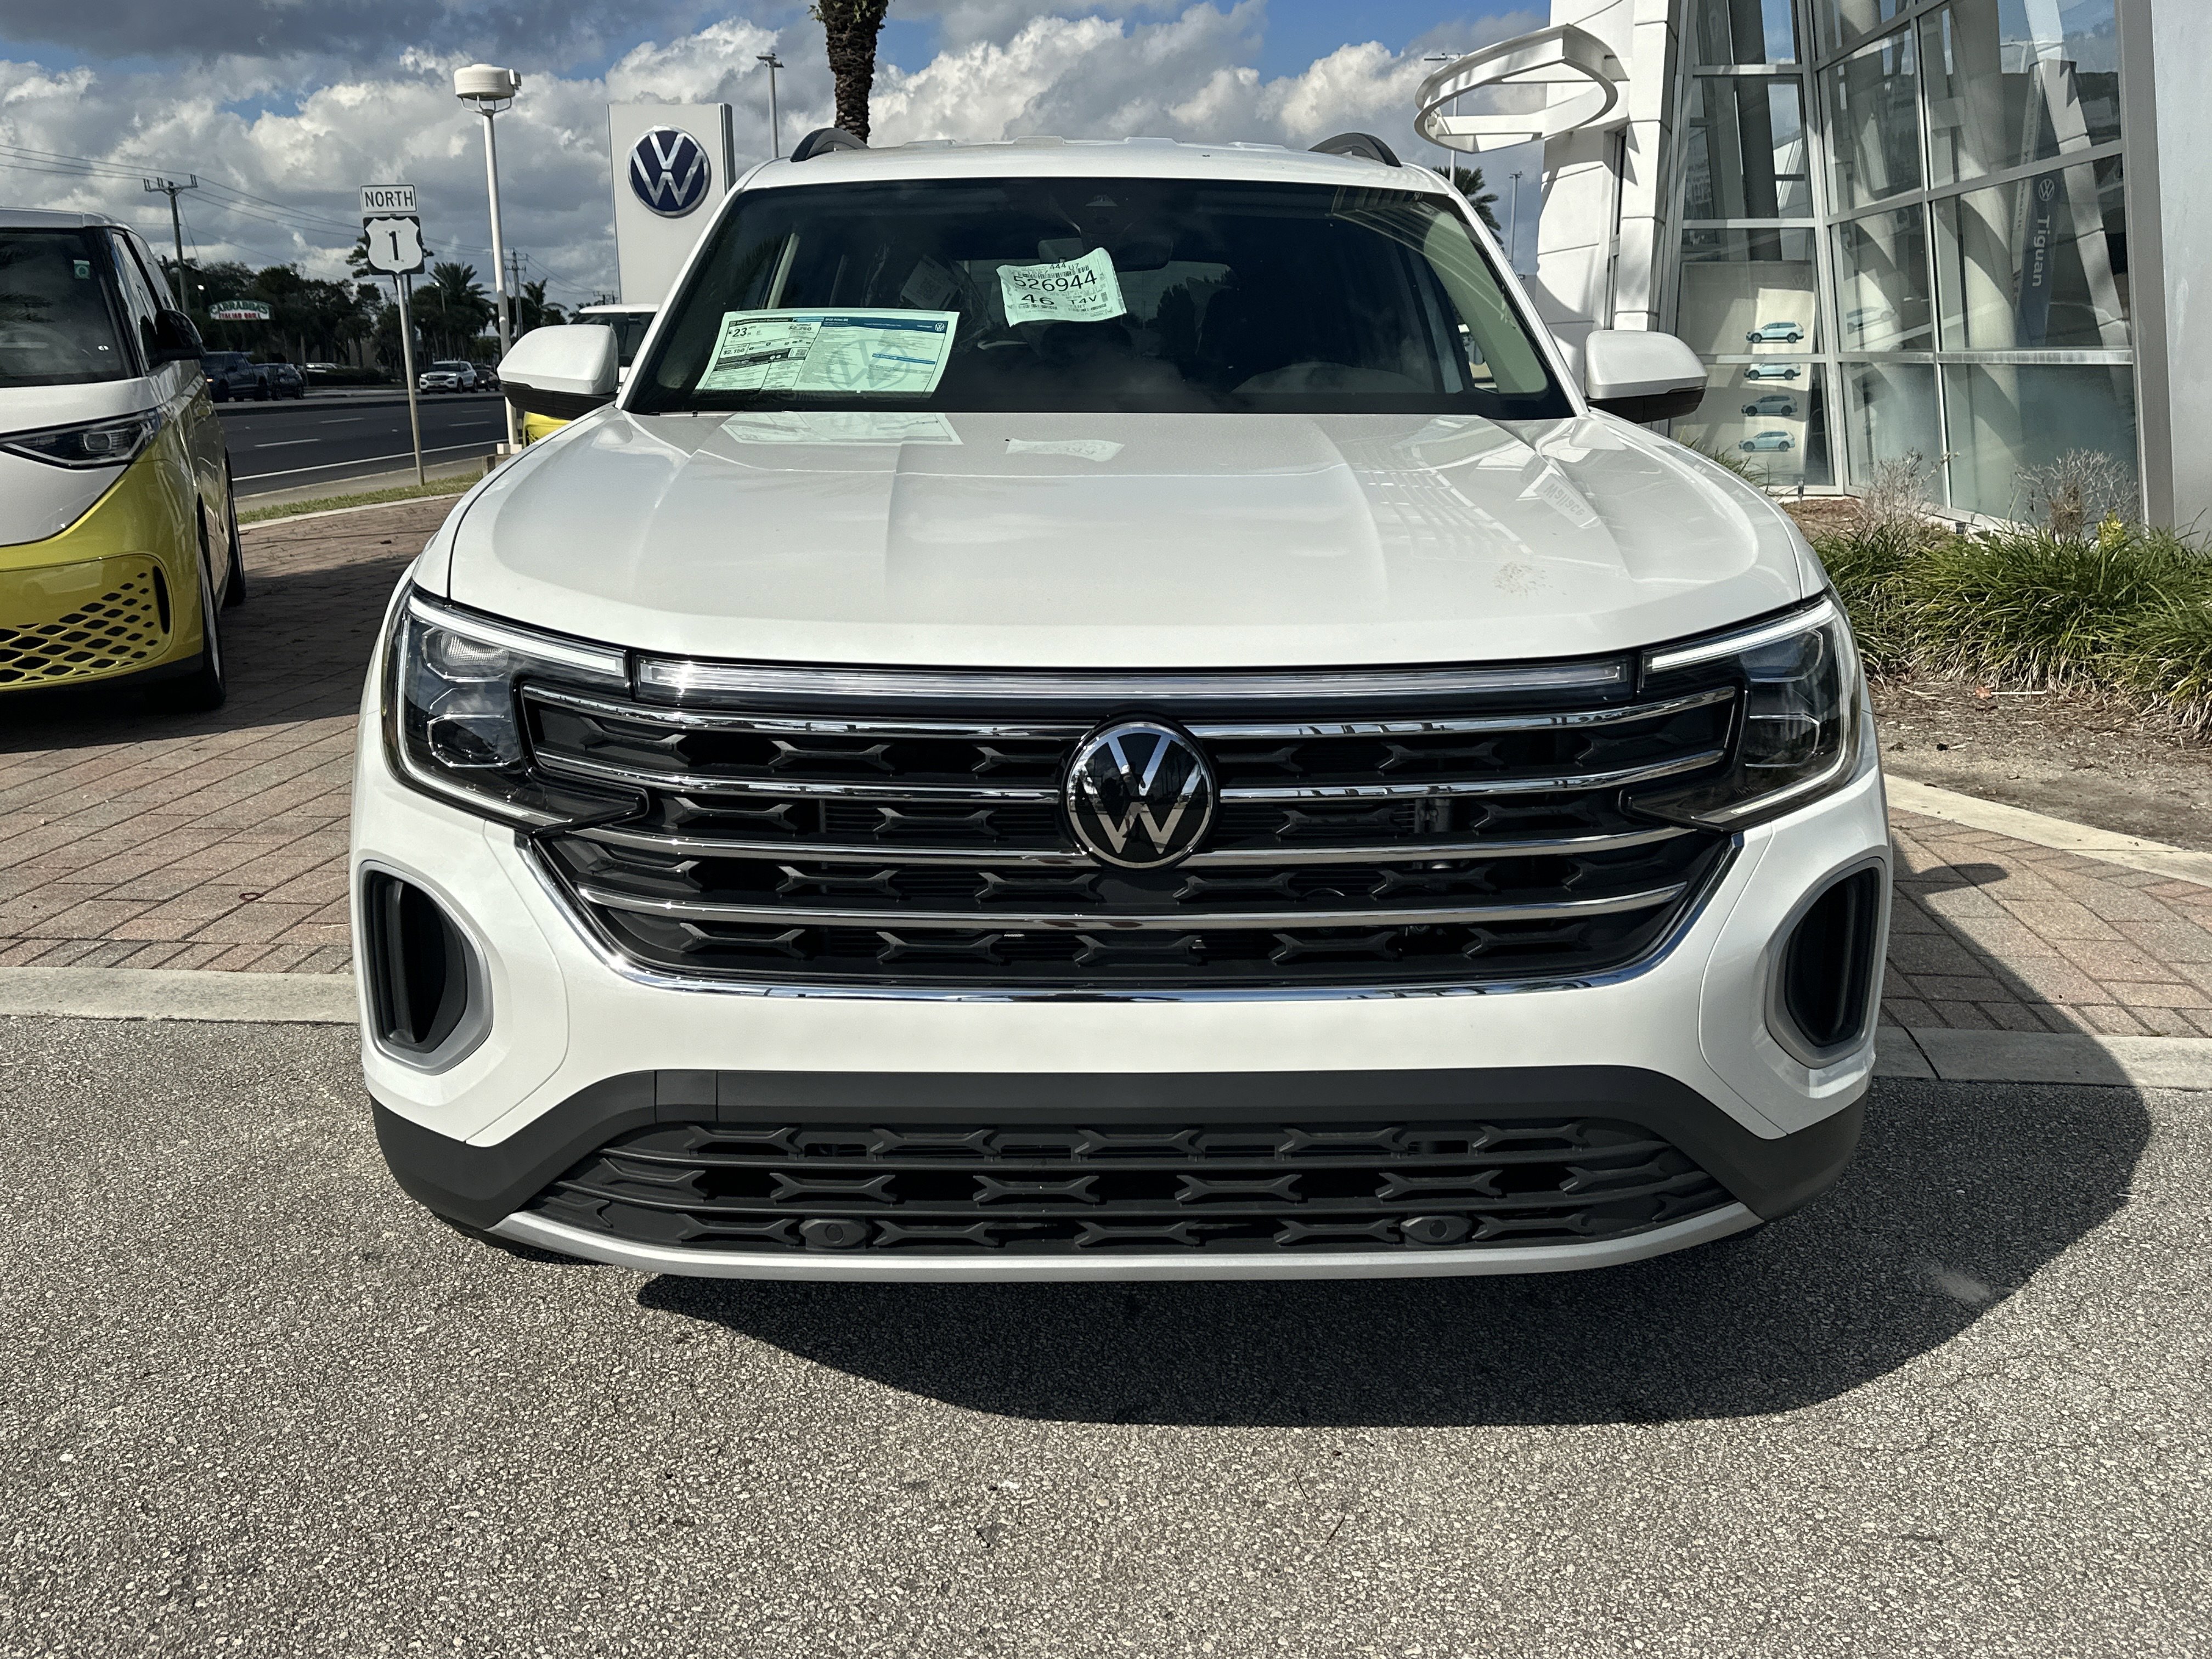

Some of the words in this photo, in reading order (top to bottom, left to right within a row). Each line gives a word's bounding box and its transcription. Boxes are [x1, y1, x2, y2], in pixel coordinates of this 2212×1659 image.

[364, 190, 414, 207] NORTH
[388, 230, 399, 261] 1
[2032, 215, 2051, 287] Tiguan
[1013, 269, 1098, 292] 526944
[1021, 294, 1054, 305] 46
[732, 328, 747, 337] 23
